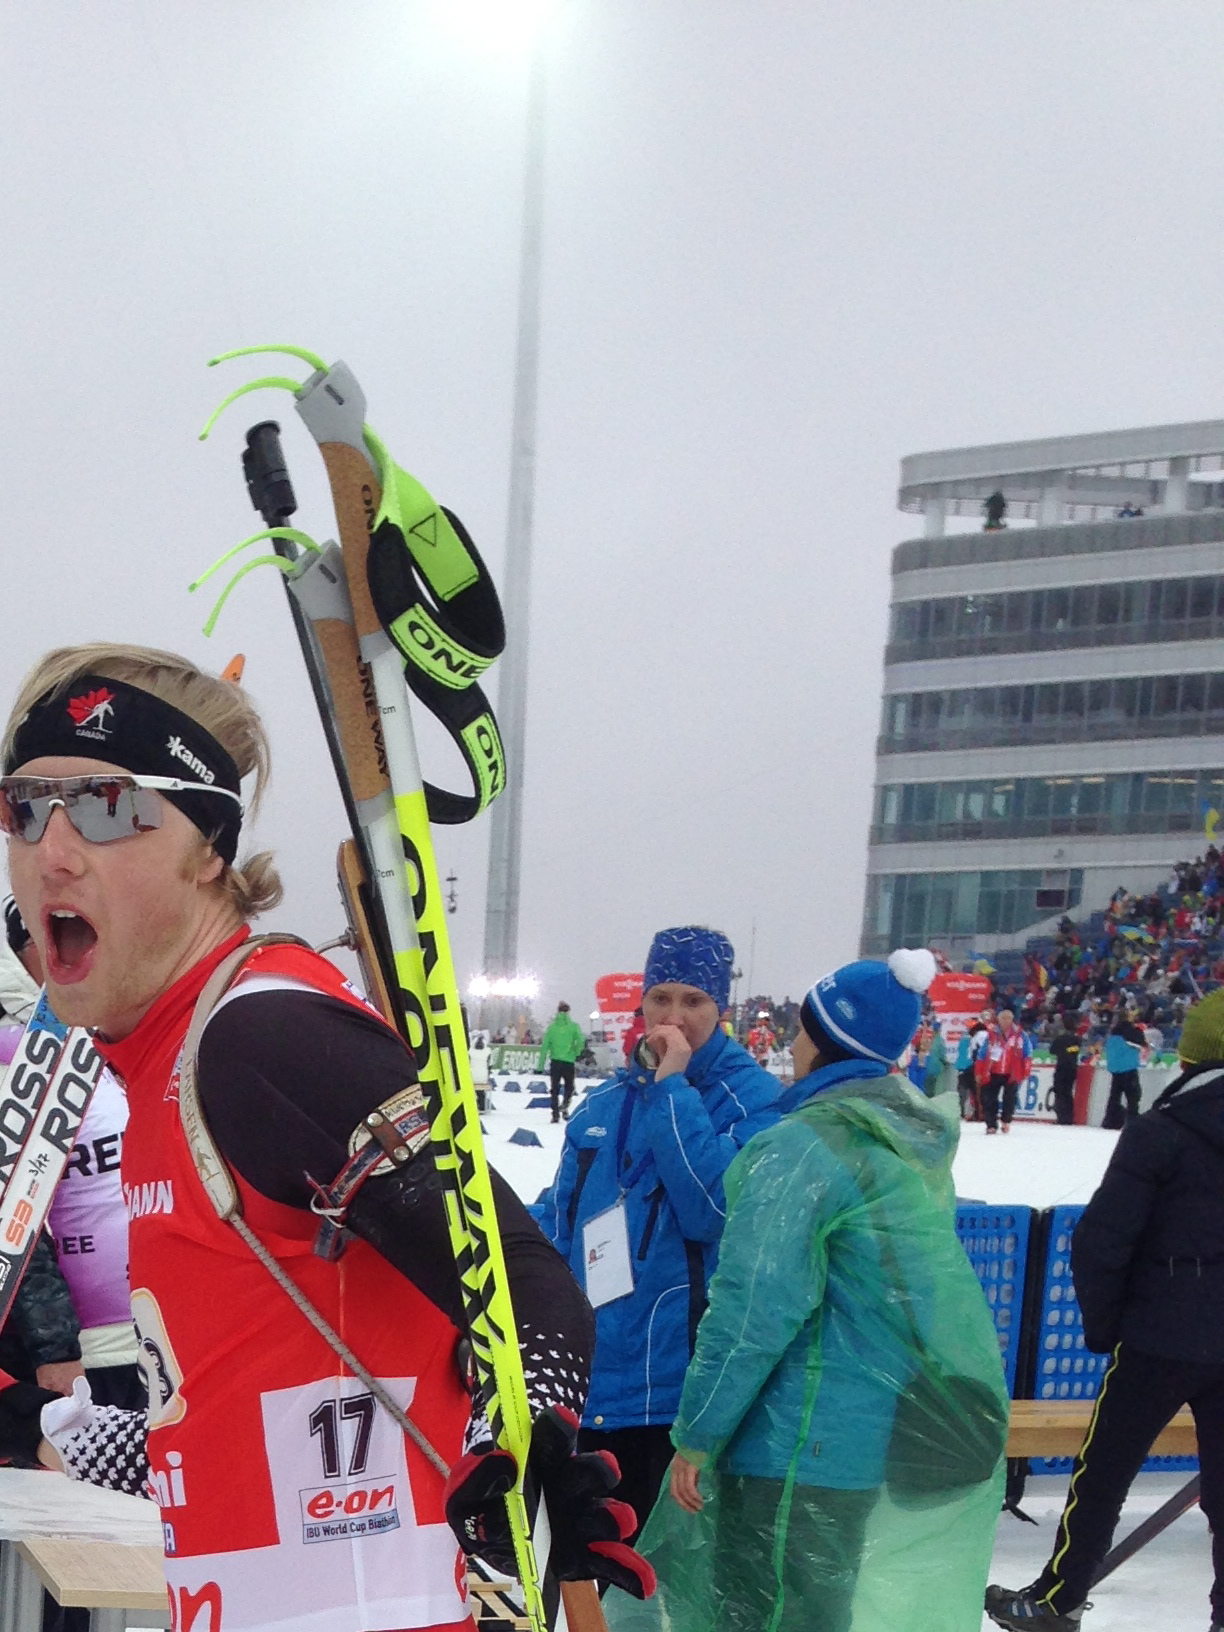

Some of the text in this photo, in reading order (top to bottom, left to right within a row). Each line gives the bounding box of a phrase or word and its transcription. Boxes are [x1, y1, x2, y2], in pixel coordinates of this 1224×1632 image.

[75, 728, 107, 741] CANADA
[308, 1391, 377, 1480] 17
[306, 1514, 397, 1539] IBU World Cup Biathlon
